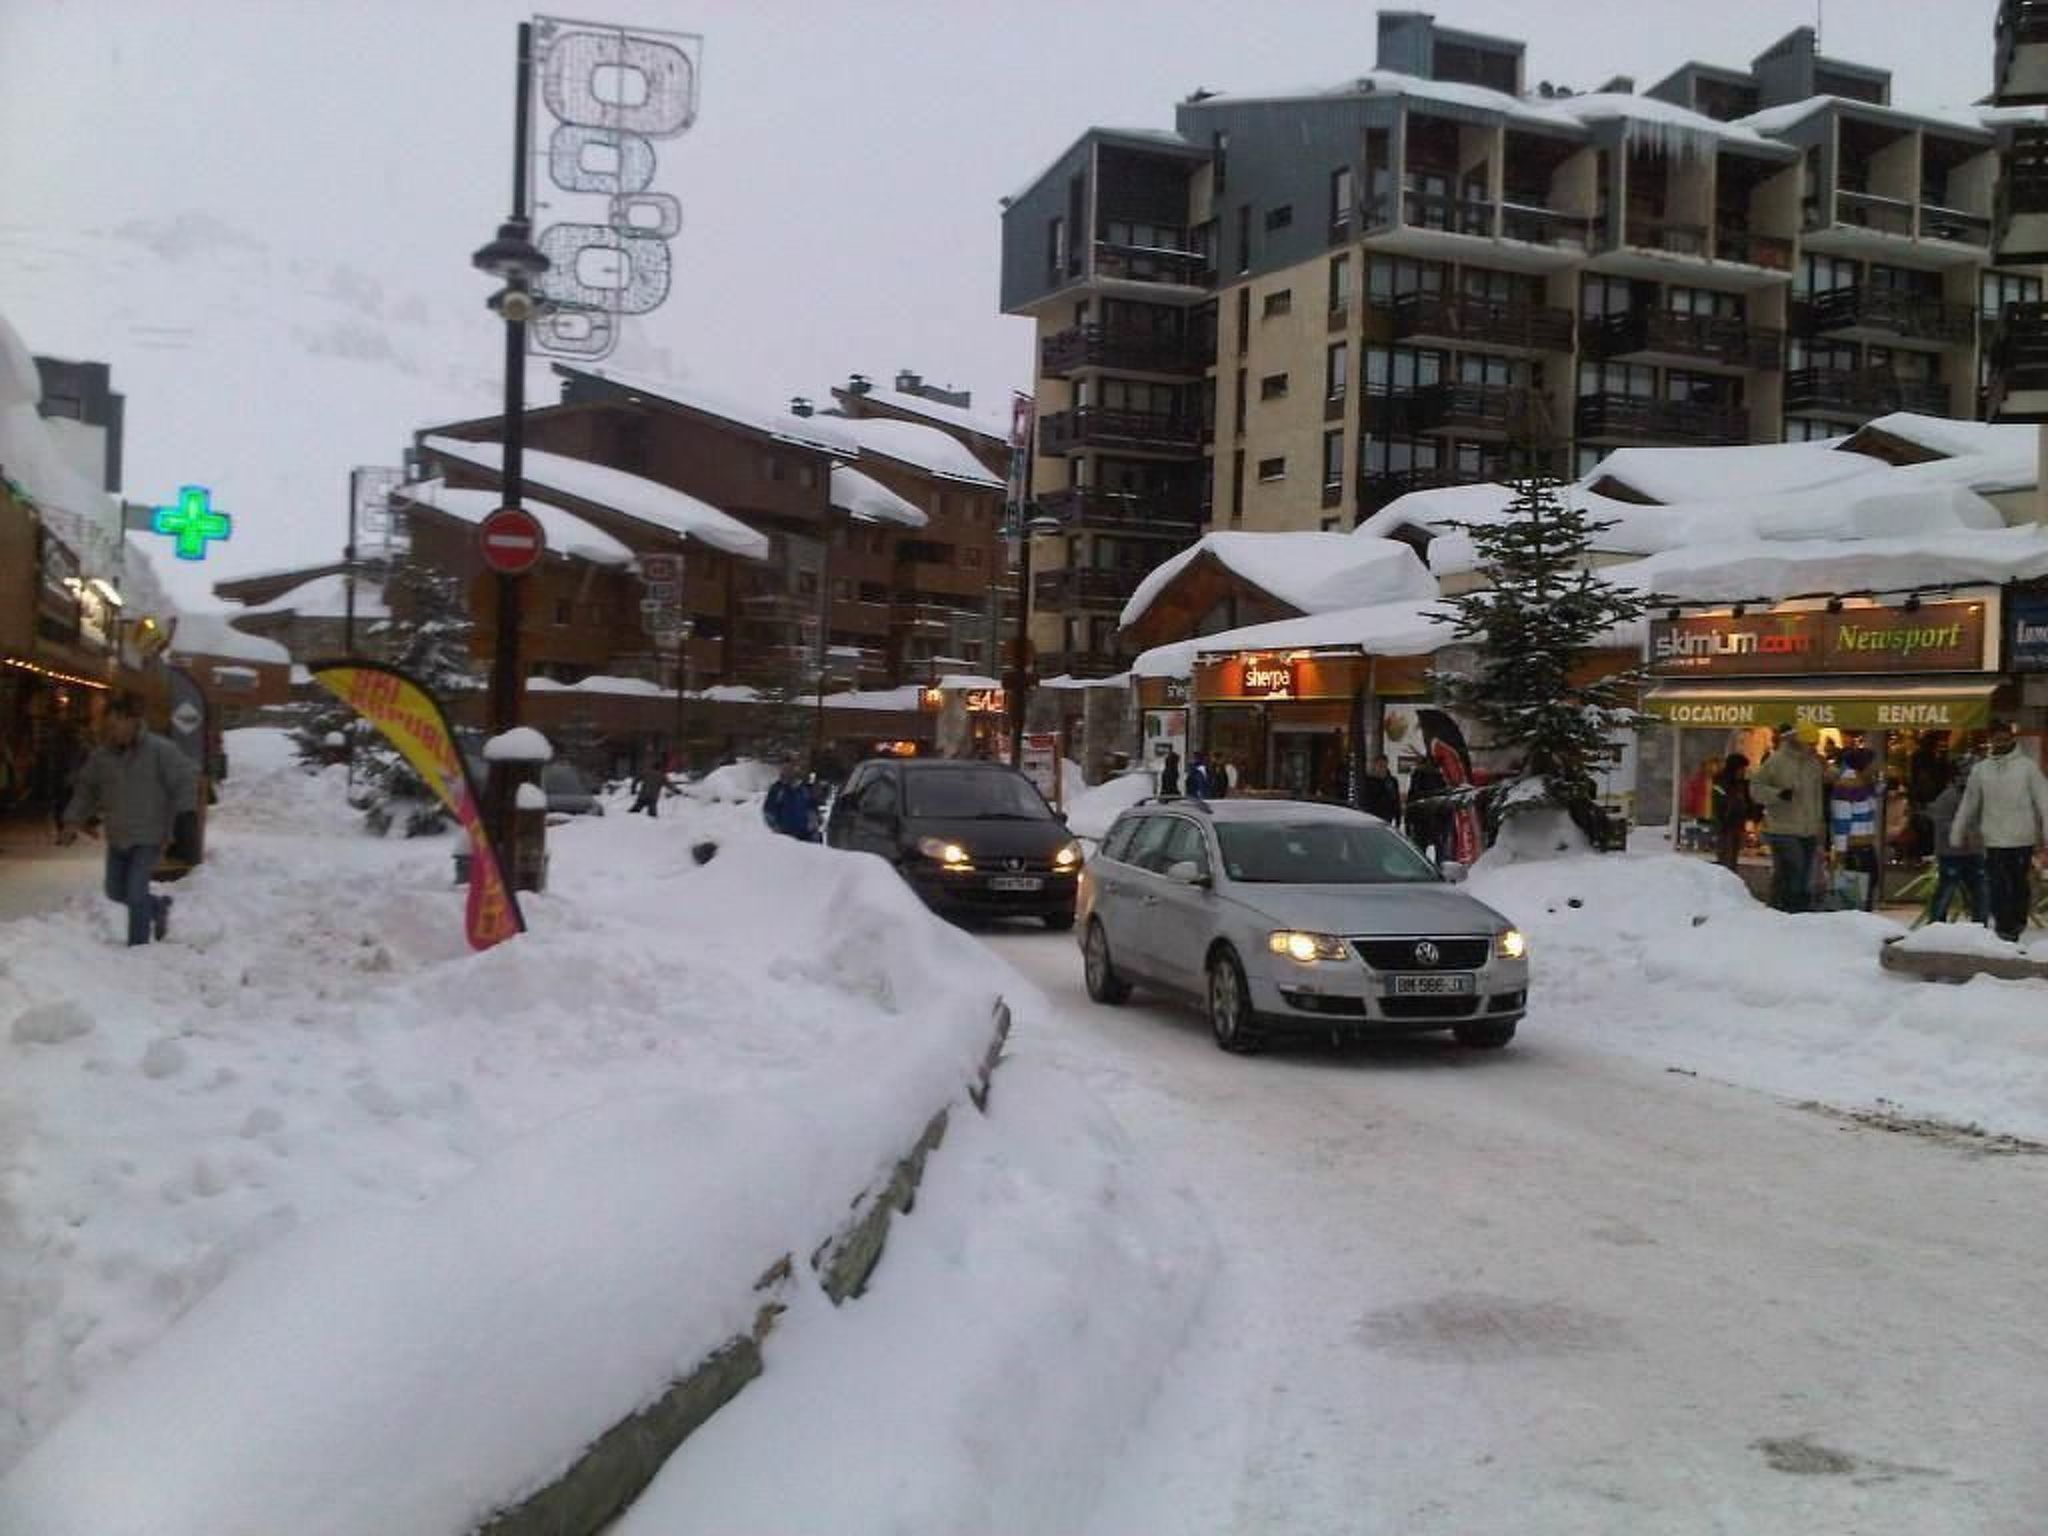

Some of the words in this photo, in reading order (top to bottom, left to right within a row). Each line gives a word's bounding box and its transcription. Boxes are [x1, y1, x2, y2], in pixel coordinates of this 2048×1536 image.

[1839, 624, 1961, 656] Newsport
[1246, 665, 1290, 689] sherpa
[1669, 705, 1754, 722] LOCATION
[1796, 705, 1836, 722] SKIS
[1878, 704, 1951, 723] RENTAL
